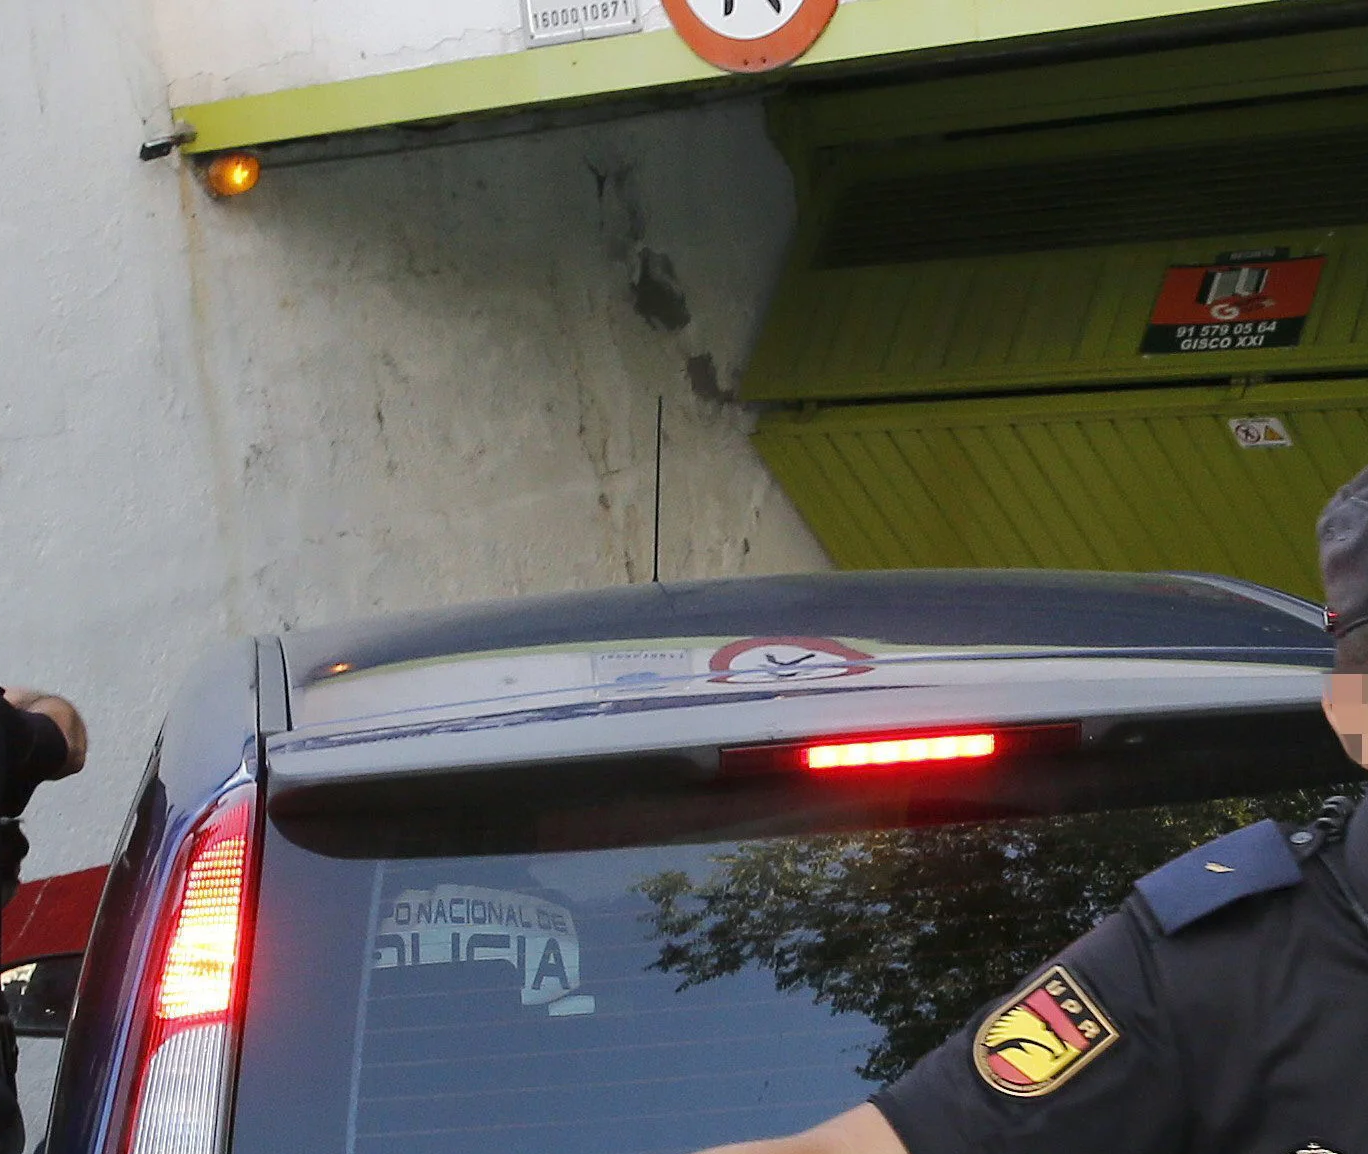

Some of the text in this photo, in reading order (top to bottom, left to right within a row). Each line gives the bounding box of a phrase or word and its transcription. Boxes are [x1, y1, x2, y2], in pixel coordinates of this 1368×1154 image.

[1234, 322, 1253, 335] 05
[1257, 320, 1278, 333] 64
[1181, 335, 1265, 350] GISCO XXI
[417, 898, 532, 929] NACIONAL
